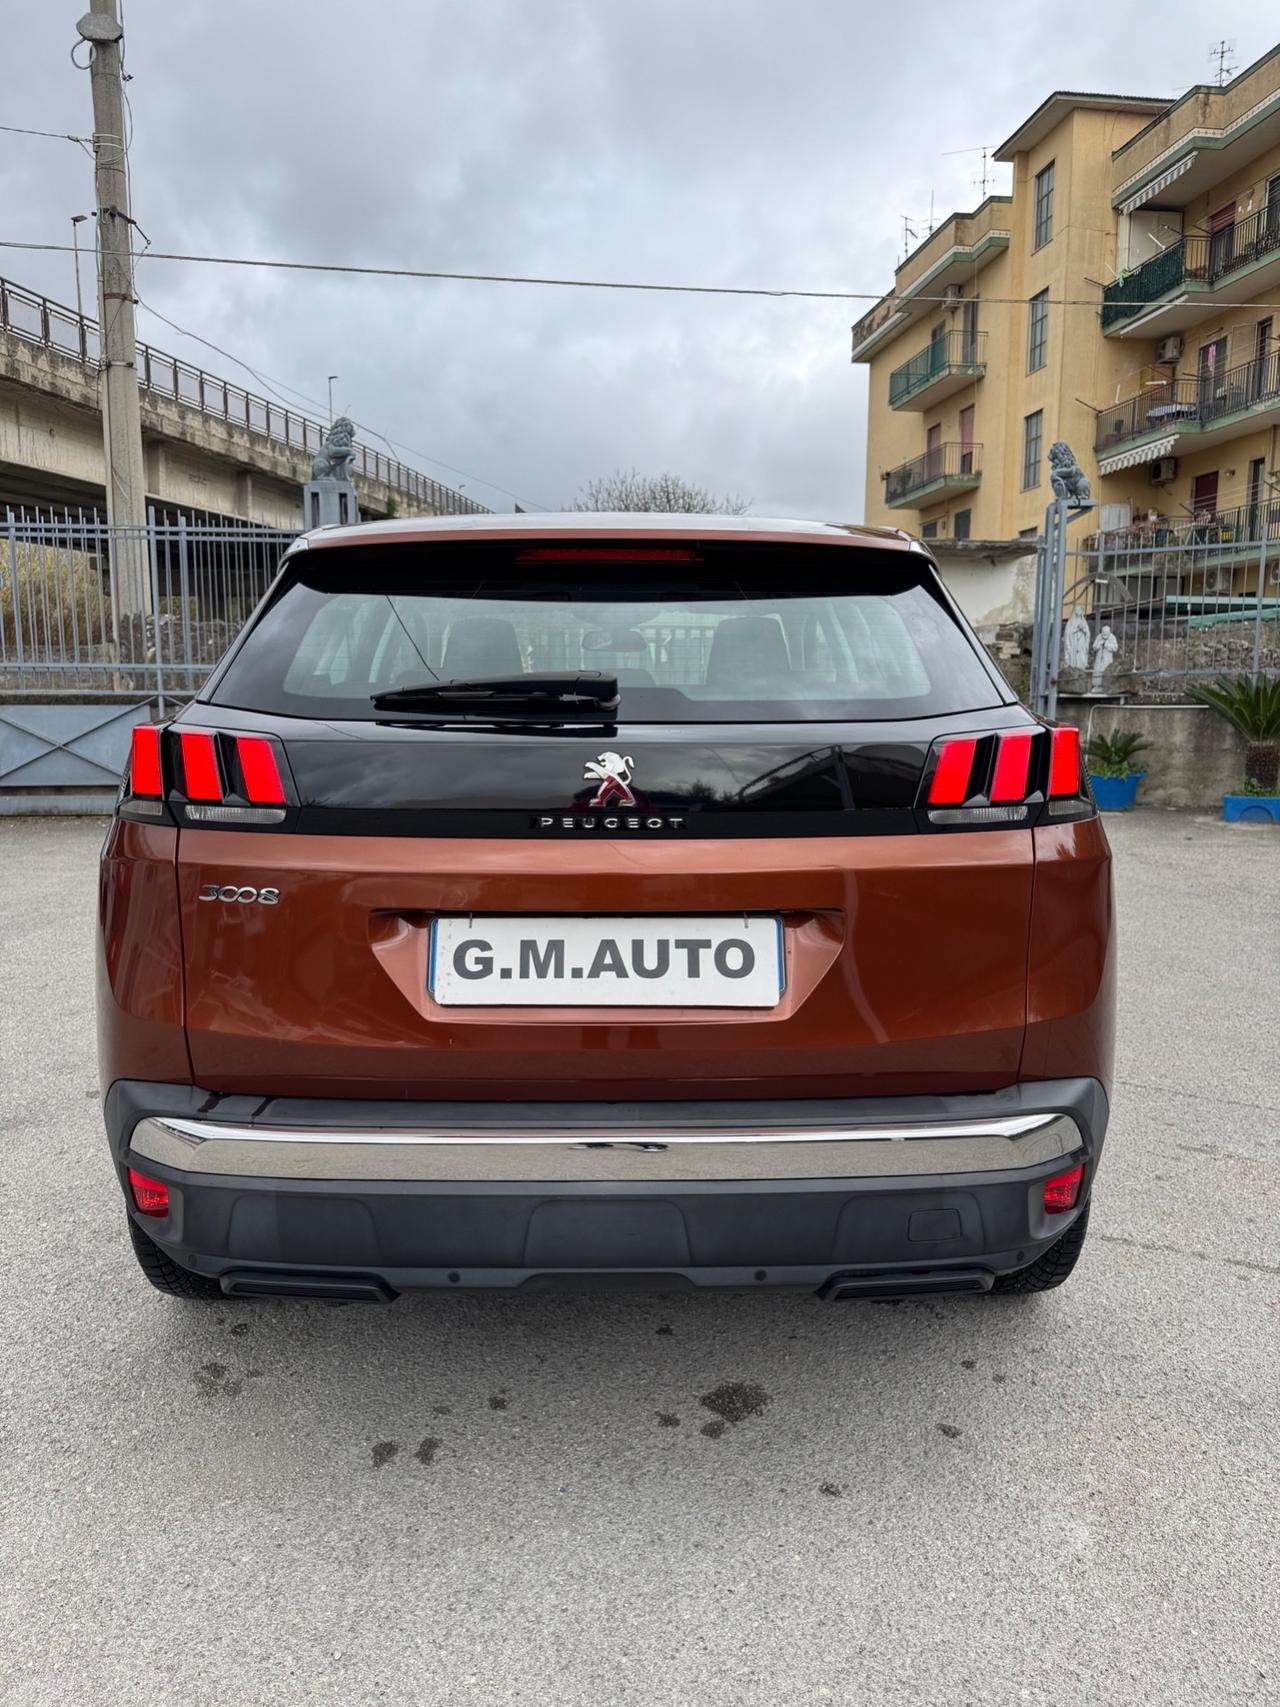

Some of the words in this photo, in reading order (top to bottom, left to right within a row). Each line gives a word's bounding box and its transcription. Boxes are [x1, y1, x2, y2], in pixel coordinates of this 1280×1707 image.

[540, 816, 684, 829] PEUGEOT
[198, 884, 280, 905] 3008
[452, 938, 755, 980] G.M.AUTO
